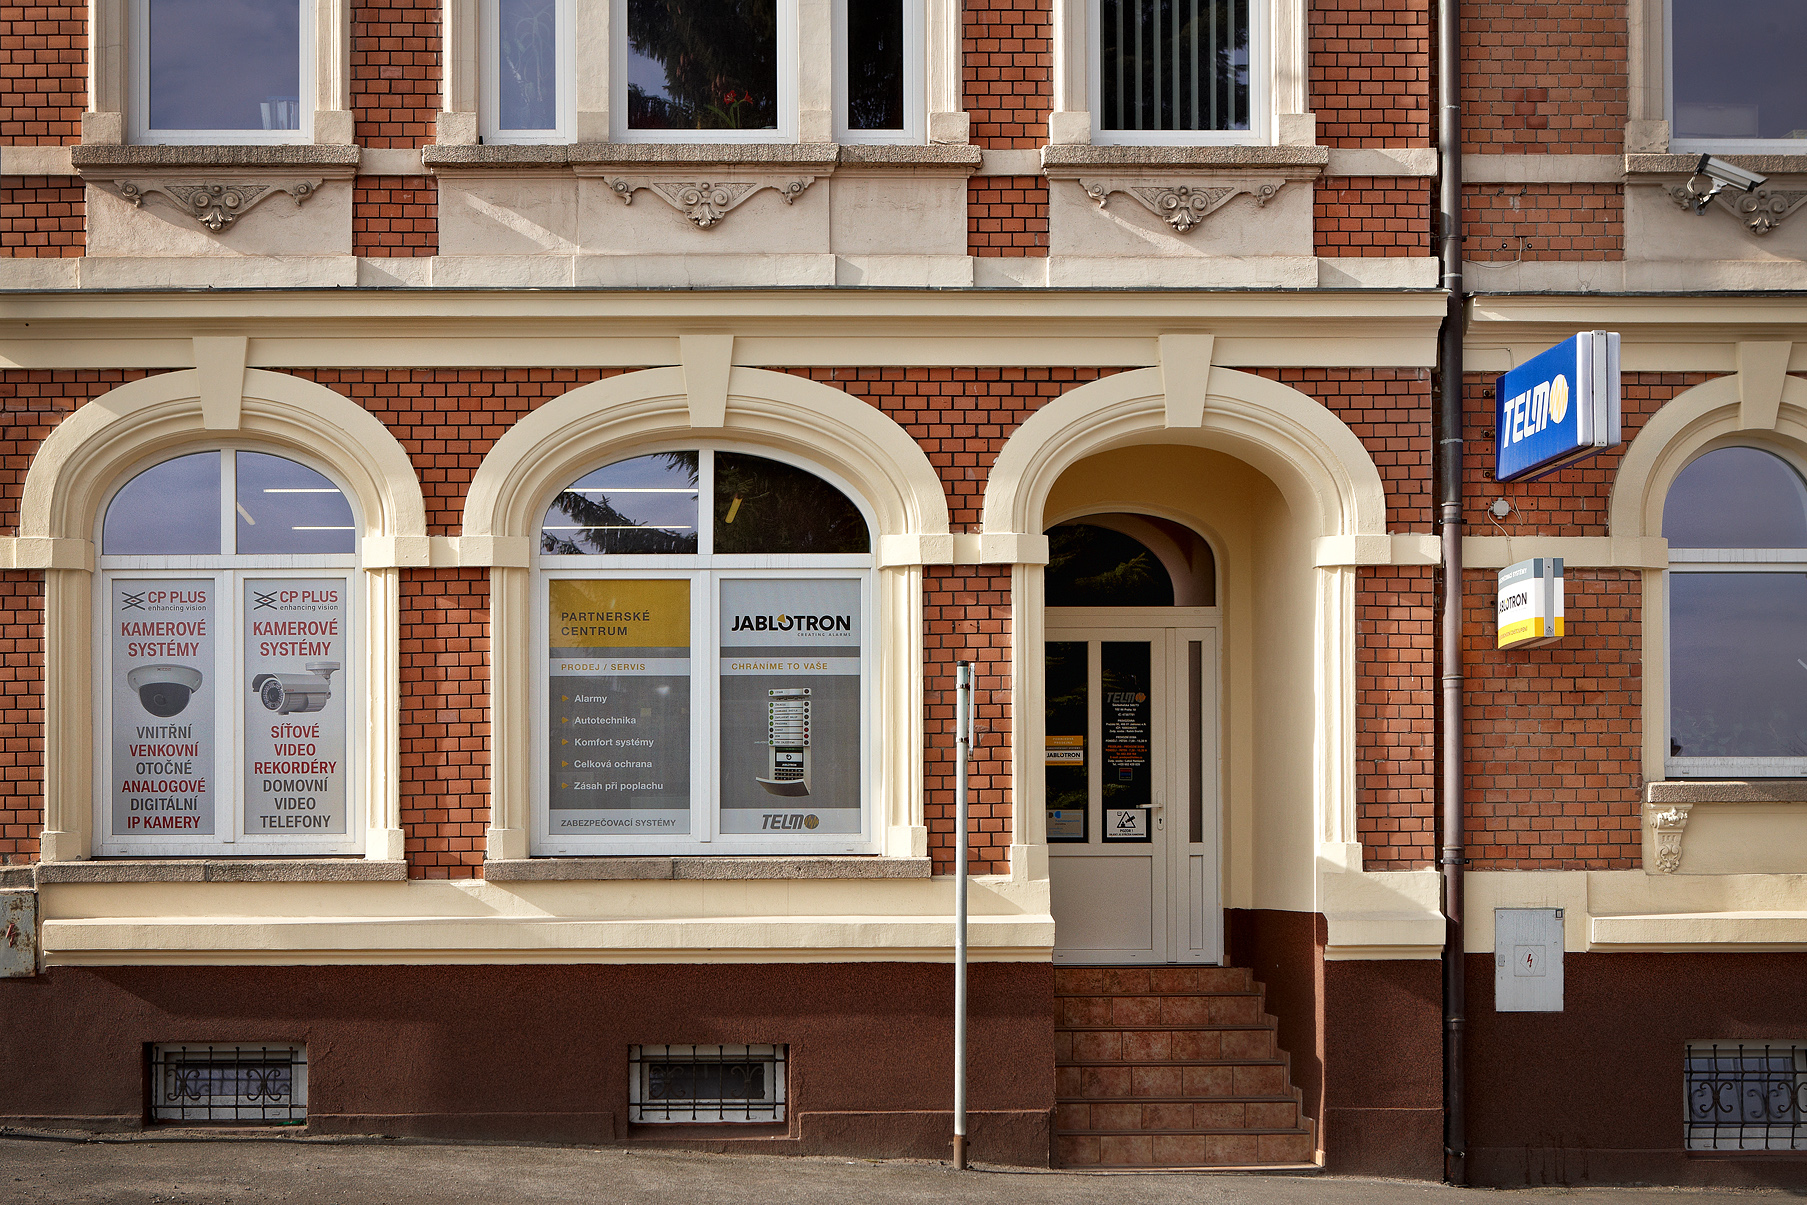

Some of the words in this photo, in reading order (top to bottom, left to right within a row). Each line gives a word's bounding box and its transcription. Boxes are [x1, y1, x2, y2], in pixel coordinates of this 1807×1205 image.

[1503, 373, 1570, 448] TELMO
[148, 591, 167, 603] CP
[170, 591, 207, 603] PLUS
[280, 591, 299, 603] CP
[302, 591, 338, 603] PLUS
[1499, 591, 1528, 615] ABLOTRON
[280, 604, 316, 612] enhancing
[561, 610, 650, 621] PARTNERSKÉ
[121, 619, 207, 636] KAMEROVÉ
[253, 618, 338, 636] KAMEROVÉ
[731, 613, 851, 632] JABLOTRON
[561, 626, 628, 636] CENTRUM
[128, 639, 200, 657] SYSTÉMY
[260, 639, 332, 656] SYSTÉMY
[561, 663, 600, 671] PRODEJ
[610, 663, 646, 671] SERVIS
[731, 661, 784, 671] CHRÁNÍME
[787, 663, 800, 671] TO
[803, 661, 828, 671] VAŠE
[574, 694, 608, 704] Alarmy
[1107, 692, 1147, 703] TELMO
[574, 716, 637, 725] Autotechnika
[136, 723, 192, 739] VNITŘNÍ
[270, 723, 320, 738] SÍŤOVÉ
[129, 741, 199, 757] VENKOVNÍ
[574, 738, 613, 747] Komfort
[615, 738, 654, 748] systémy
[274, 744, 316, 756] VIDEO
[135, 759, 193, 775] OTOČNÉ
[254, 759, 337, 774] REKORDÉRY
[574, 760, 612, 768] Celková
[614, 760, 653, 768] ochrana
[121, 777, 206, 793] ANALOGOVÉ
[263, 777, 329, 792] DOMOVNÍ
[574, 782, 603, 790] Zásah
[605, 782, 618, 791] při
[620, 782, 664, 791] poplachu
[130, 795, 198, 811] DIGITÁLNÍ
[274, 797, 316, 810] VIDEO
[127, 816, 141, 829] IP
[143, 816, 201, 829] KAMERY
[260, 815, 331, 828] TELEFONY
[560, 818, 633, 827] ZABEZPEČOVACÍ
[635, 818, 676, 827] SYSTÉMY
[762, 813, 820, 830] TELMO
